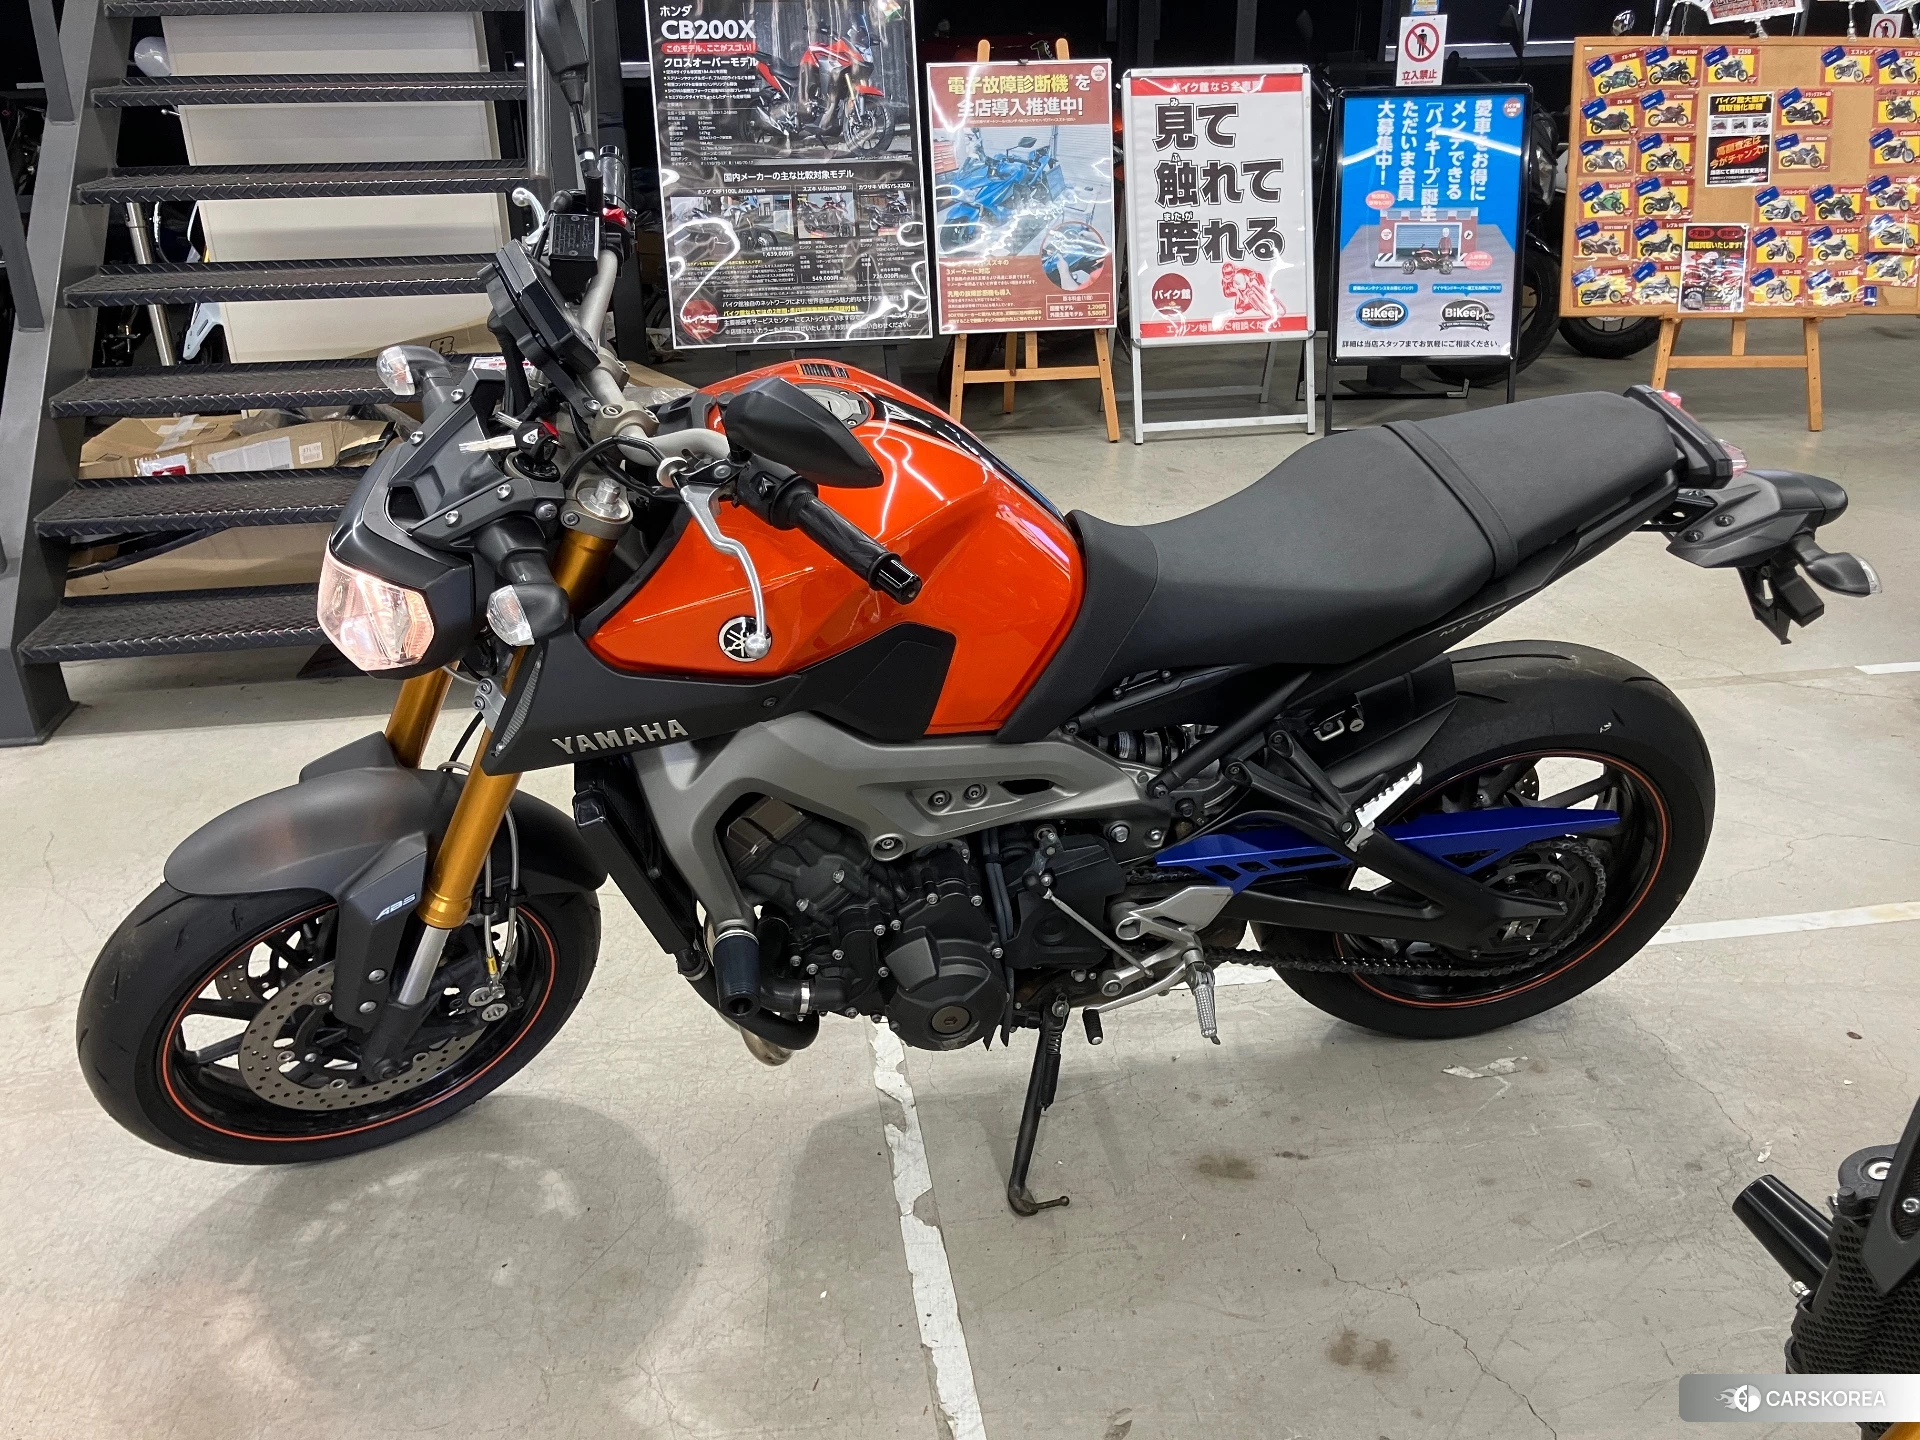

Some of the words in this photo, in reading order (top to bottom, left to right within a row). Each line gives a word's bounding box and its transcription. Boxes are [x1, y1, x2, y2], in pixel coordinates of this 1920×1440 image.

[660, 5, 692, 17] ホンダ
[661, 20, 756, 39] CB200X
[664, 57, 758, 67] クロスオーバーモデル
[1402, 69, 1438, 80] 立入禁止
[957, 97, 1083, 117] 全店導入推進中!
[1152, 103, 1239, 152] 見て
[1375, 100, 1396, 185] 大募集中!
[1397, 100, 1419, 202] ただいま会員
[1446, 100, 1466, 200] メンテできる
[724, 171, 854, 182] 国内メーカーの主な比較対象モデル
[1154, 158, 1284, 208] 触れて
[1162, 211, 1194, 222] またが
[1156, 216, 1286, 266] 跨れる
[1361, 304, 1404, 321] Bikeep
[551, 719, 689, 755] YAMAHA
[375, 893, 416, 921] ABS
